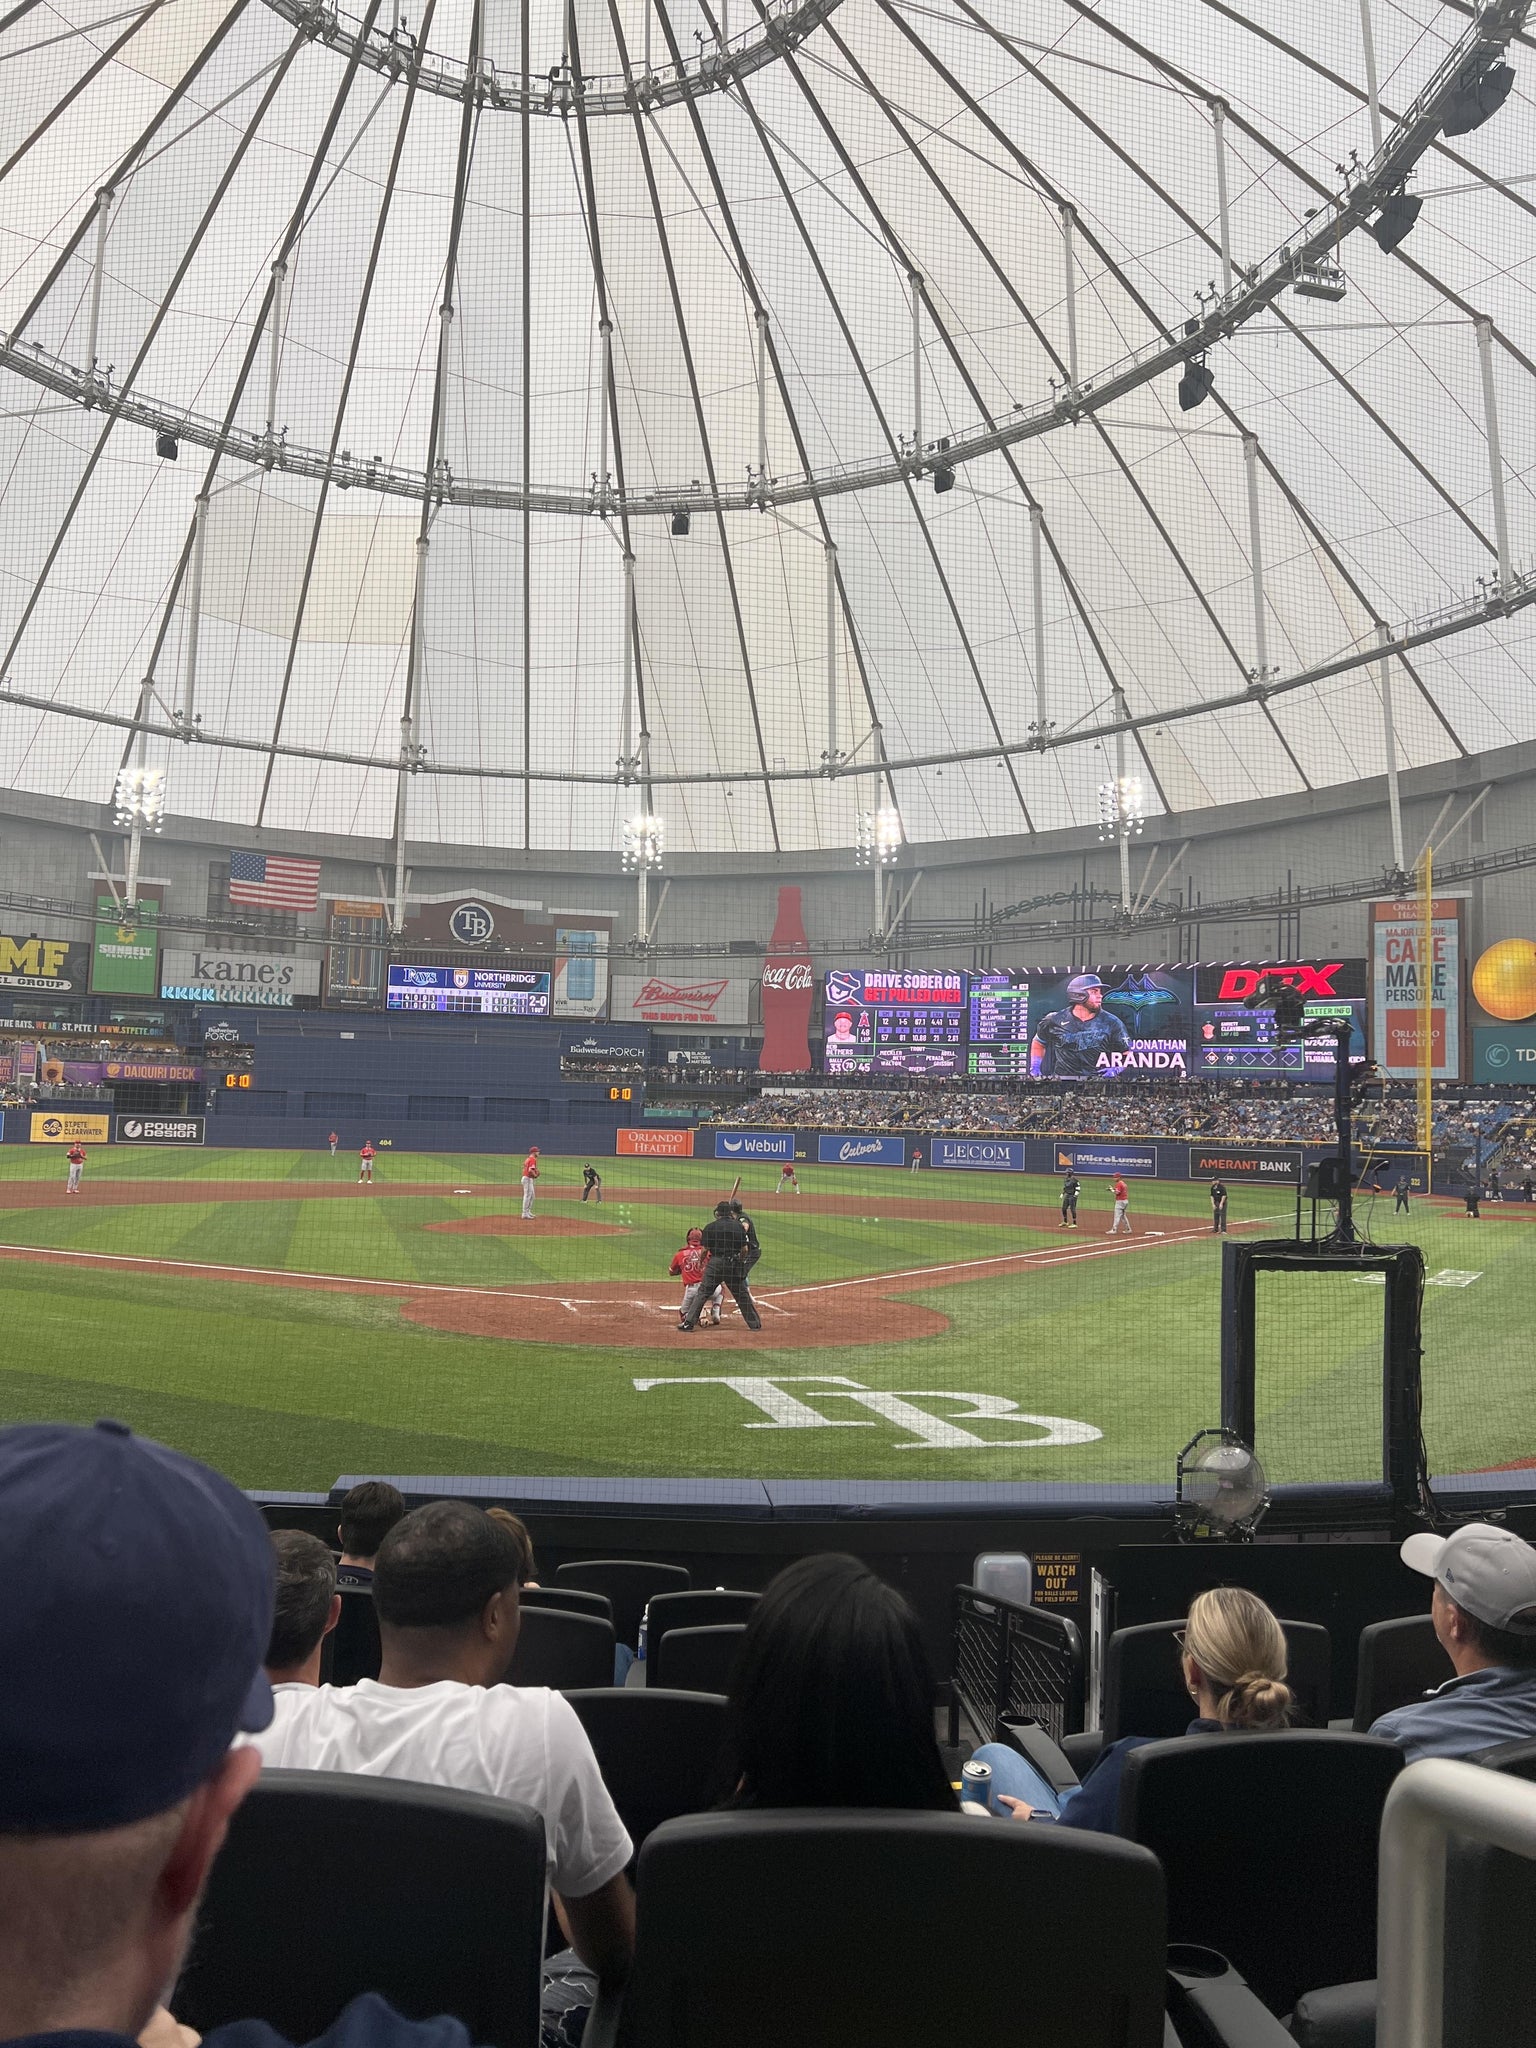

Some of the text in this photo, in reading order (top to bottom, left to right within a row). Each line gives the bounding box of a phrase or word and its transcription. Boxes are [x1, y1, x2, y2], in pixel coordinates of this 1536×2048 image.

[1393, 903, 1439, 911] ORLANO
[459, 911, 486, 937] TB
[1386, 927, 1445, 937] MAJOR LEGUE
[99, 944, 152, 956] SUNBELT
[191, 953, 294, 984] kane's
[474, 972, 536, 983] NORTHBRIDGE
[763, 964, 813, 990] Coca-Cola
[865, 973, 960, 989] DRIVE SOBER OR
[18, 978, 64, 988] GROUP
[642, 986, 720, 1001] Budweiser
[864, 988, 960, 1002] GET PULLED OVER
[529, 996, 546, 1006] 2-0
[642, 1012, 658, 1020] THIS
[684, 1013, 698, 1021] FOR
[700, 1014, 717, 1022] YOU.
[0, 1019, 14, 1027] THE
[15, 1020, 34, 1029] RAYS.
[36, 1021, 46, 1029] WE
[205, 1032, 239, 1040] PORCH
[1392, 1029, 1440, 1038] ORLANO
[1131, 1040, 1186, 1050] JONATHAN
[570, 1046, 645, 1056] Budweiser PORCH
[1096, 1052, 1185, 1068] ARANDA
[124, 1065, 195, 1079] DAIQUIRI DECK
[830, 1064, 841, 1072] 33
[858, 1063, 870, 1072] 45
[226, 1075, 250, 1087] 0:10
[610, 1088, 631, 1099] 0:10
[628, 1131, 683, 1143] ORLANDO
[635, 1142, 677, 1153] HEALTH
[744, 1138, 786, 1152] Webull
[840, 1139, 883, 1161] Culver's
[1077, 1155, 1152, 1164] MicroLumen
[1200, 1159, 1291, 1172] AMERANT BANK
[633, 1376, 1103, 1449] TB
[1037, 1565, 1076, 1576] WATCH
[1046, 1578, 1067, 1589] OUT
